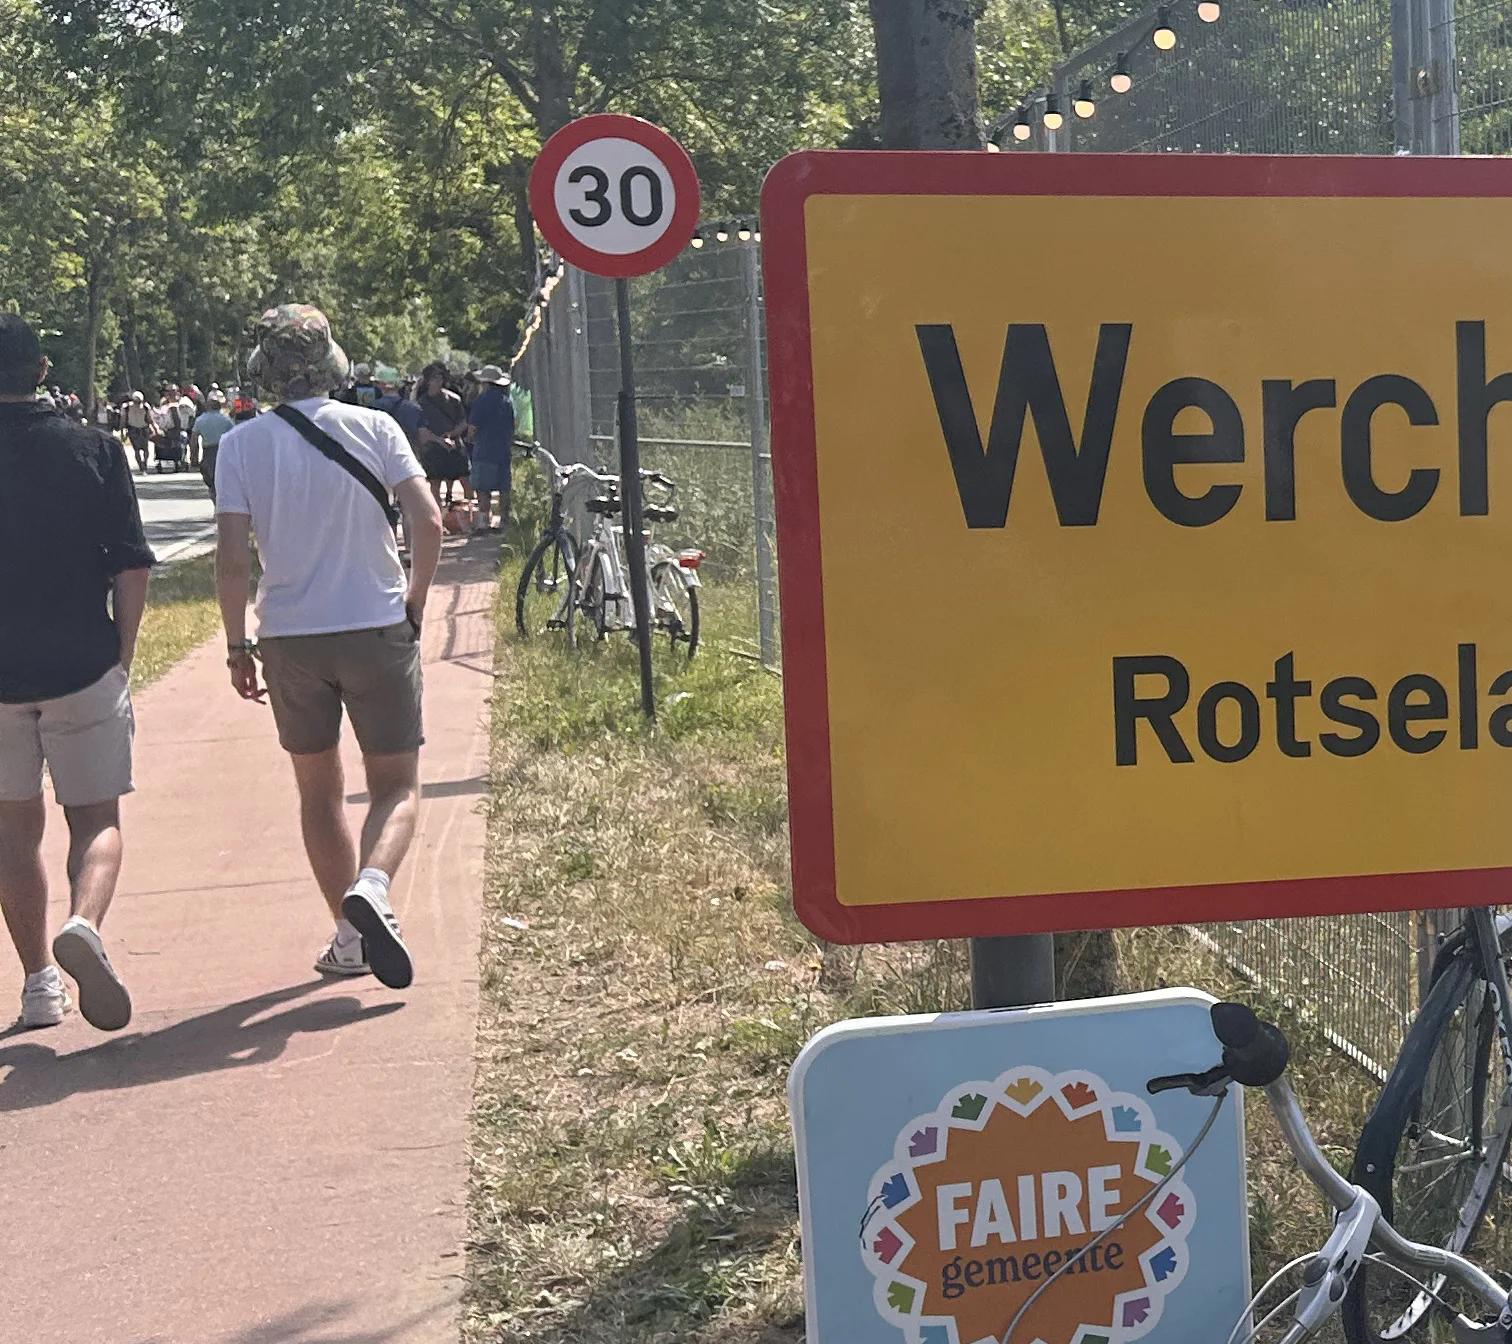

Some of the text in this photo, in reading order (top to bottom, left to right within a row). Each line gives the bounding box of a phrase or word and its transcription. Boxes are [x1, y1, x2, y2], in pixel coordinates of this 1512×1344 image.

[568, 165, 663, 227] 30
[935, 1164, 1124, 1252] FAIRE
[941, 1241, 1125, 1299] gemeente
